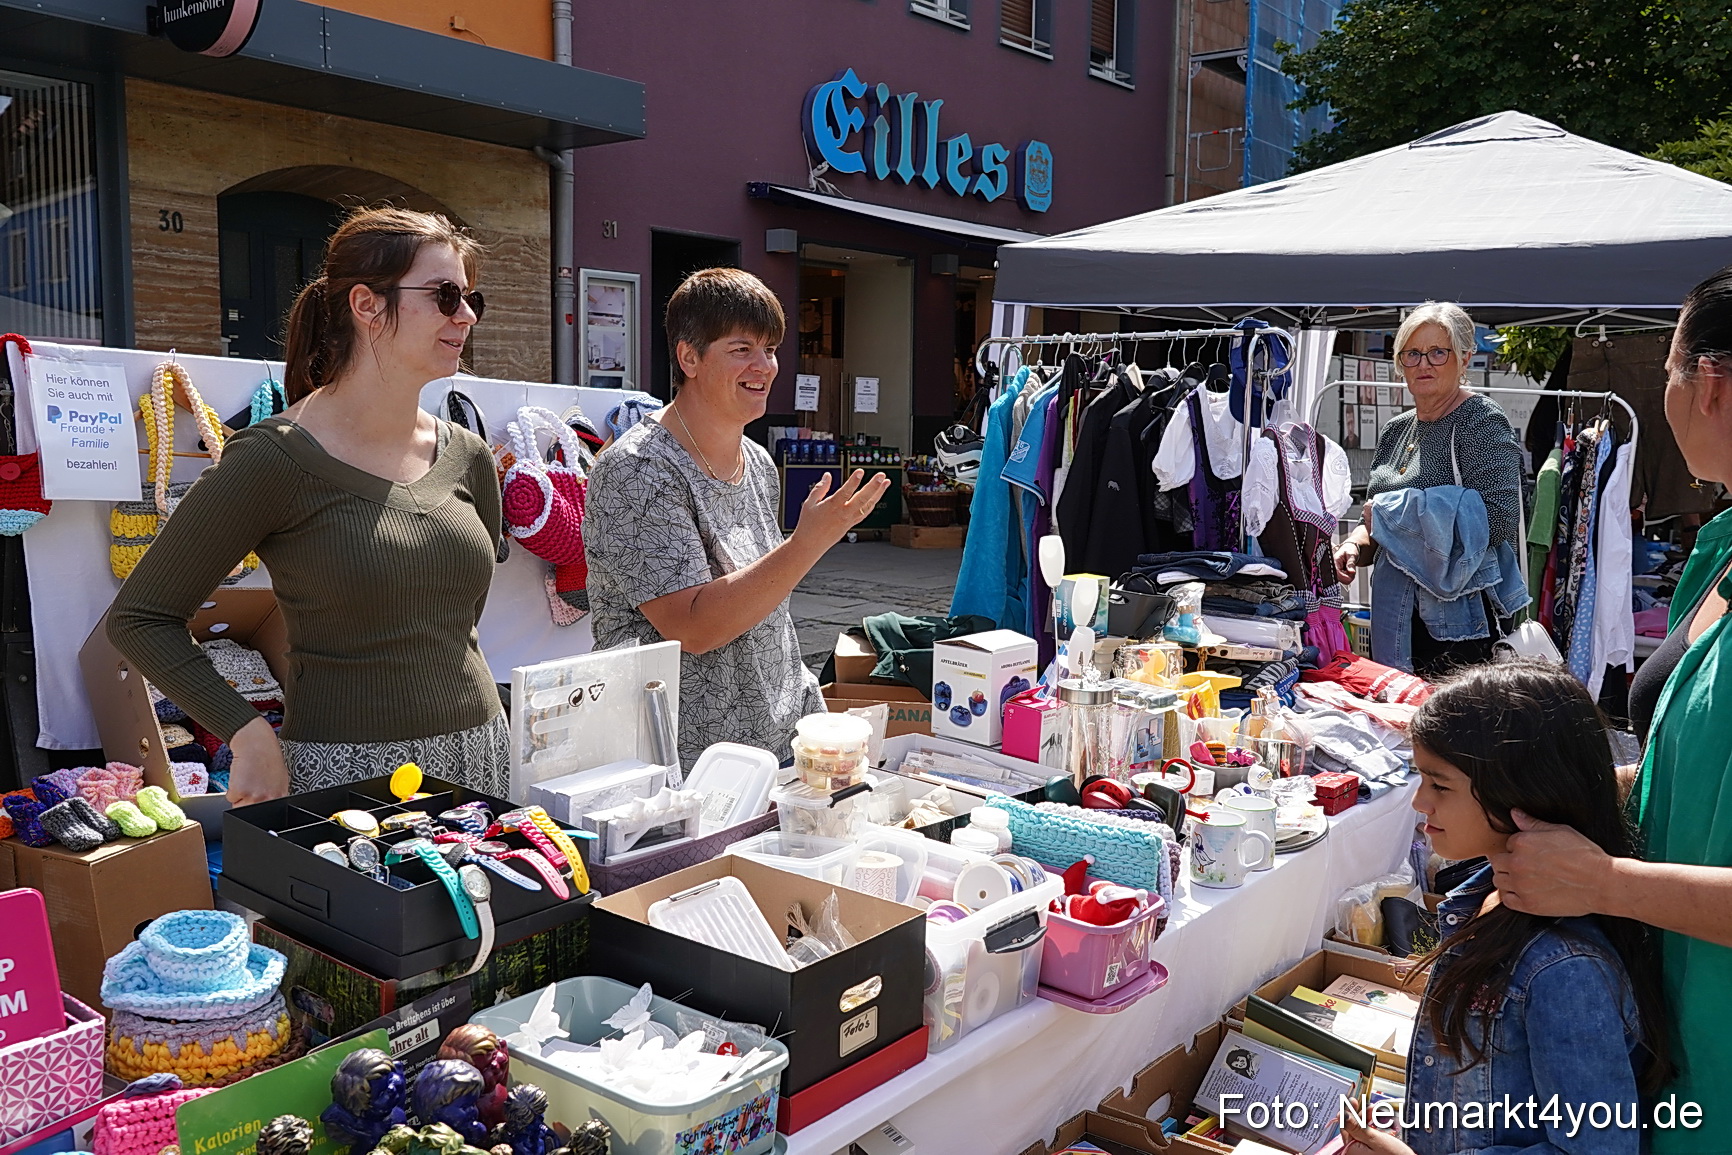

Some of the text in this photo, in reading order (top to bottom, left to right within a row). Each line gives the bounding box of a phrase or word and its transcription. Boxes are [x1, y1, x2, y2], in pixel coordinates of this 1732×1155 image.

[807, 67, 1010, 202] Eilles
[159, 209, 184, 233] 30
[602, 219, 618, 239] 31
[46, 373, 110, 388] Hier können
[47, 387, 114, 402] Sie auch mit
[69, 410, 122, 426] PayPal
[60, 422, 105, 434] Freunde
[71, 437, 110, 449] Familie
[66, 458, 118, 471] bezahlen!
[395, 1007, 432, 1030] Brettchens
[431, 1001, 441, 1013] ist
[440, 995, 456, 1009] über
[414, 1026, 430, 1043] alt
[194, 1119, 261, 1155] Kalorien
